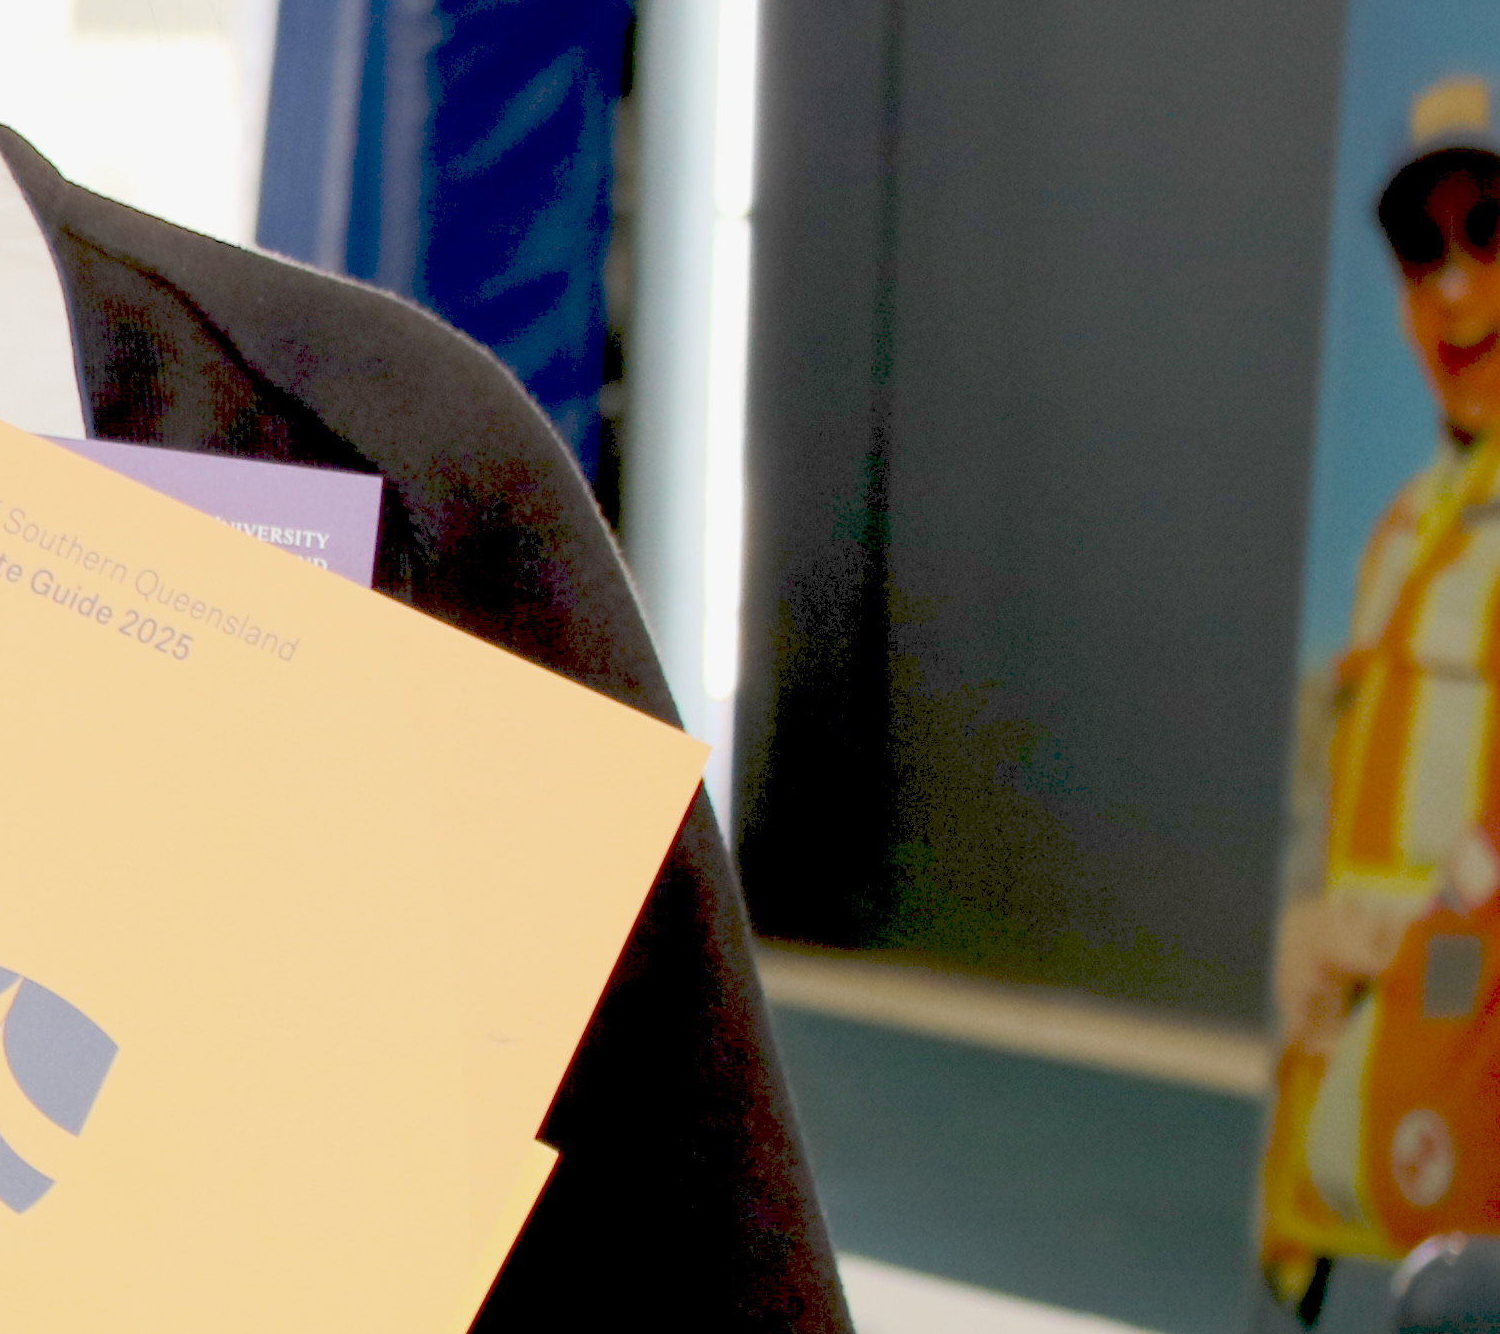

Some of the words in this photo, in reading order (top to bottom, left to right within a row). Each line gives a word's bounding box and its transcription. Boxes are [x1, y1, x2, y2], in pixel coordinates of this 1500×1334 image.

[214, 515, 330, 550] VERSITY
[2, 507, 129, 585] Southern
[134, 568, 300, 662] Queensland
[30, 568, 114, 625] Guide
[118, 610, 195, 661] 2025
